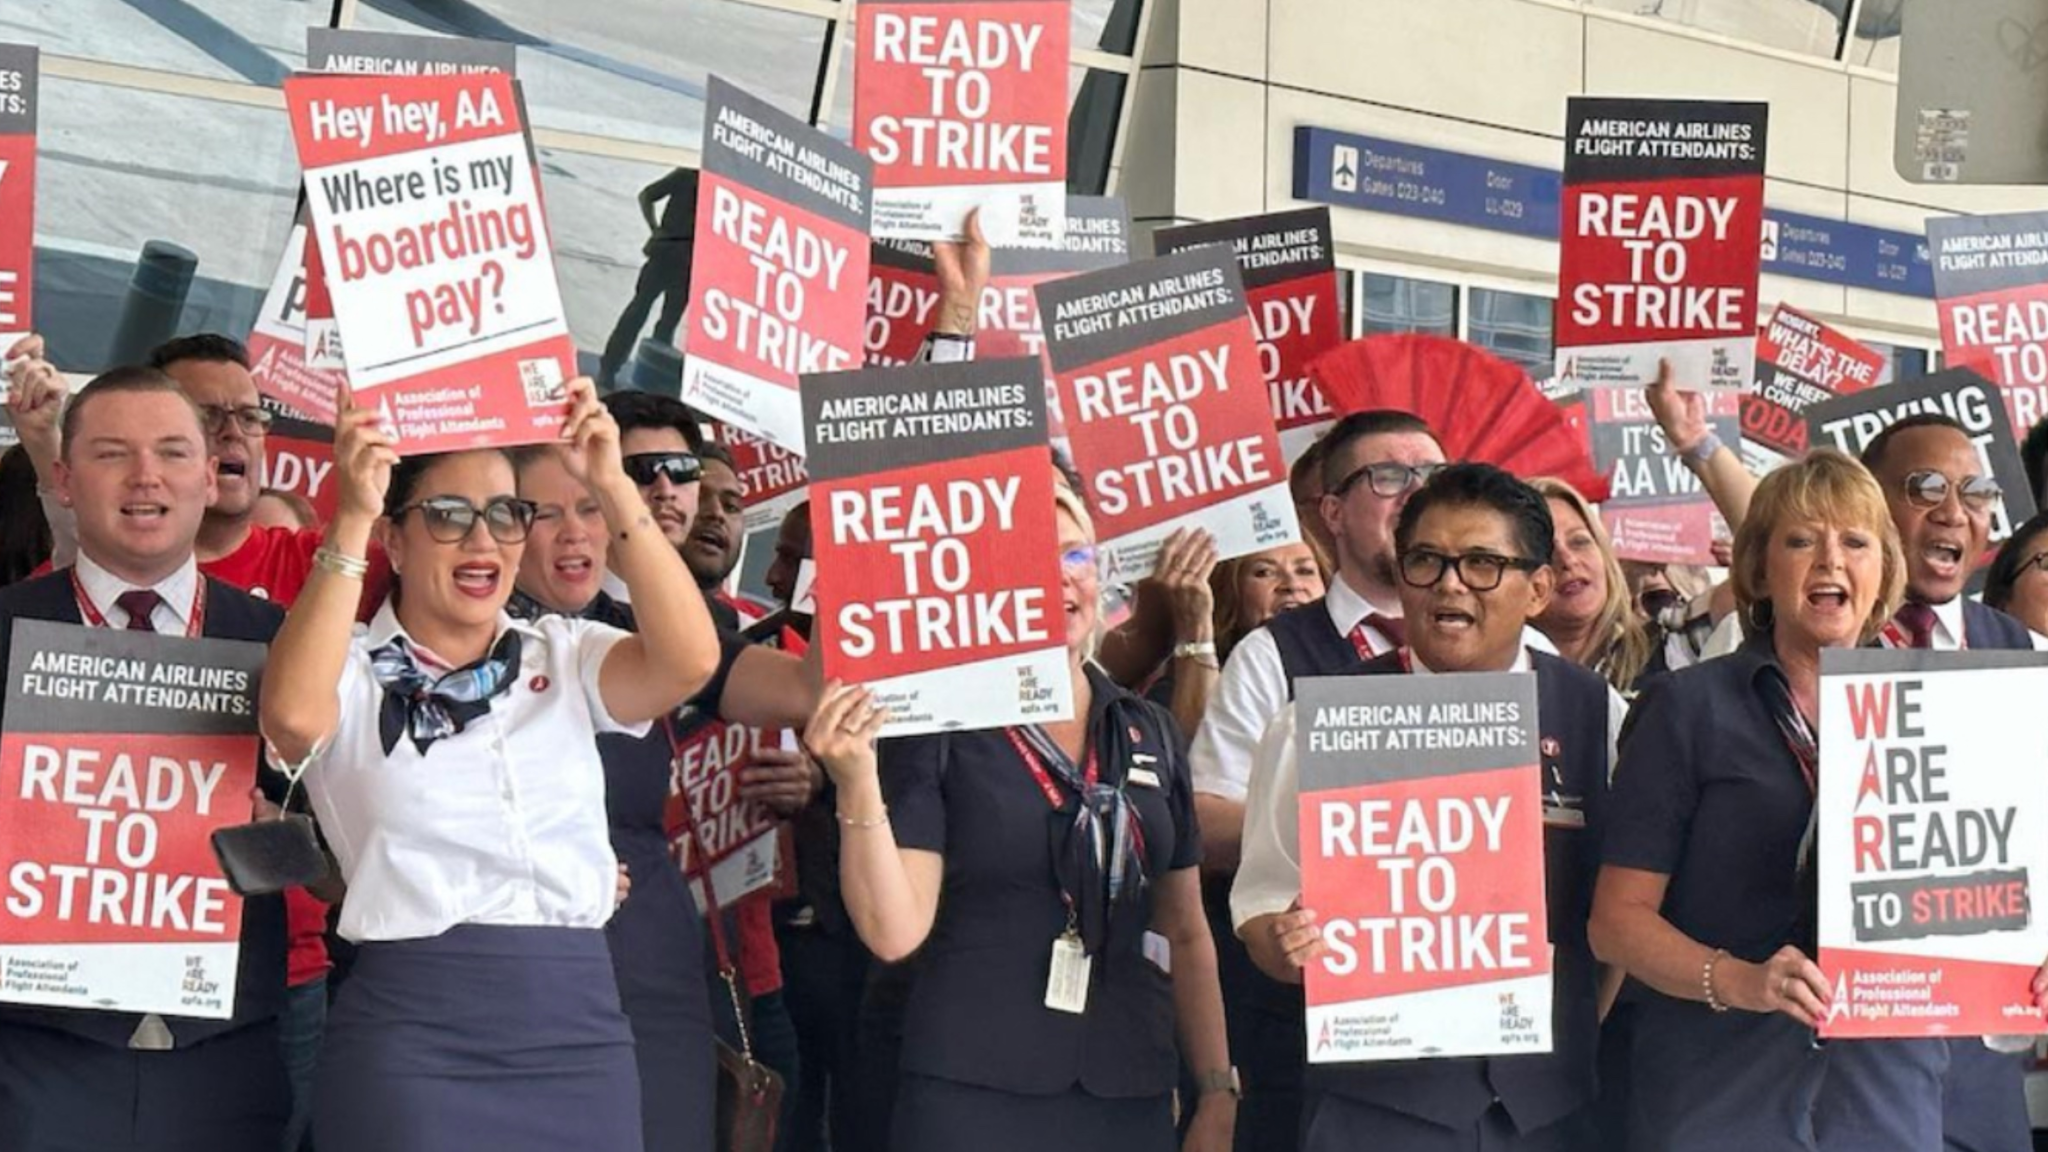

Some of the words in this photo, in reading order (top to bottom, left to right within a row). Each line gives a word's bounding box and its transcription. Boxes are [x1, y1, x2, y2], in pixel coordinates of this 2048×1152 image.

[873, 12, 1044, 73] READY
[324, 54, 417, 76] AMERICAN
[921, 67, 992, 120] TO
[309, 98, 374, 149] Hey
[380, 93, 447, 143] hey,
[455, 87, 504, 130] AA
[1580, 120, 1670, 139] AMERICAN
[1674, 122, 1752, 141] AIRLINES
[718, 105, 796, 158] AMERICAN
[797, 146, 862, 193] AIRLINES
[868, 114, 1053, 175] STRIKE
[1364, 149, 1425, 177] Departures
[1574, 138, 1635, 156] FLIGHT
[1637, 139, 1756, 161] ATTENDANTS:
[322, 168, 426, 216] Where
[431, 156, 461, 197] is
[469, 154, 514, 197] my
[712, 122, 764, 163] FLIGHT
[766, 153, 865, 215] ATTENDANTS:
[1362, 176, 1395, 199] Gates
[1486, 169, 1514, 191] Door
[873, 199, 924, 211] Association
[1577, 193, 1739, 241] READY
[334, 199, 537, 283] boarding
[711, 184, 849, 293] READY
[1252, 227, 1318, 250] AIRLINES
[1782, 222, 1831, 246] Departures
[1941, 236, 2012, 254] AMERICAN
[1622, 239, 1688, 285] TO
[1940, 252, 1986, 272] FLIGHT
[405, 260, 505, 349] pay?
[749, 253, 805, 323] TO
[1055, 285, 1144, 321] AMERICAN
[1149, 267, 1224, 300] AIRLINES
[1571, 283, 1745, 331] STRIKE
[702, 287, 852, 376] STRIKE
[1054, 311, 1119, 342] FLIGHT
[1117, 286, 1234, 328] ATTENDANTS:
[1952, 300, 2048, 347] READ
[1767, 322, 1836, 367] WHAT'S
[1837, 352, 1874, 385] THE
[1775, 349, 1844, 390] DELAY?
[1994, 341, 2048, 386] TO
[395, 387, 467, 405] Association
[468, 384, 482, 400] of
[820, 391, 928, 421] AMERICAN
[933, 384, 1026, 412] AIRLINES
[1073, 345, 1231, 423] READY
[1773, 370, 1796, 395] WE
[397, 402, 475, 421] Professional
[401, 422, 438, 441] Flight
[440, 415, 506, 434] Attendants
[815, 419, 887, 444] FLIGHT
[893, 408, 1034, 438] ATTENDANTS:
[1130, 403, 1200, 458] TO
[1621, 423, 1667, 456] IT'S
[1094, 435, 1271, 517] STRIKE
[1610, 457, 1657, 498] AA
[829, 475, 1022, 545] READY
[889, 537, 972, 596] TO
[837, 587, 1049, 658] STRIKE
[30, 650, 146, 681] AMERICAN
[151, 662, 249, 692] AIRLINES
[1016, 664, 1033, 678] WE
[22, 673, 100, 701] FLIGHT
[103, 682, 252, 716] ATTENDANTS:
[1018, 687, 1054, 702] READY
[1314, 704, 1422, 728] AMERICAN
[1428, 701, 1521, 725] AIRLINES
[1845, 680, 1925, 740] WE
[1309, 729, 1381, 752] FLIGHT
[1386, 725, 1528, 749] ATTENDANTS:
[20, 744, 228, 816] READY
[689, 769, 732, 820] TO
[1853, 741, 1950, 814] ARE
[77, 807, 159, 869] TO
[1319, 796, 1513, 858] READY
[1852, 805, 2018, 874] READY
[5, 860, 231, 934] STRIKE
[1376, 855, 1458, 915] TO
[1856, 892, 1903, 930] TO
[1911, 880, 2025, 925] STRIKE
[7, 956, 66, 970] Association
[67, 960, 79, 972] of
[1321, 912, 1532, 976] STRIKE
[4, 979, 34, 992] Flight
[35, 982, 89, 996] Attendants
[6, 968, 68, 983] Professional
[181, 978, 219, 995] READY
[1852, 968, 1926, 984] Association
[1928, 969, 1943, 984] of
[1852, 985, 1932, 1001] Professional
[1333, 1014, 1387, 1027] Association
[1388, 1012, 1400, 1024] of
[1498, 992, 1515, 1005] WE
[1852, 1002, 1889, 1020] Flight
[1891, 1002, 1960, 1018] Attendants
[2001, 1004, 2043, 1019] apfa.org
[1333, 1025, 1392, 1037] Professional
[1333, 1037, 1361, 1050] Flight
[1362, 1035, 1413, 1048] Attendants
[1499, 1015, 1534, 1030] READY
